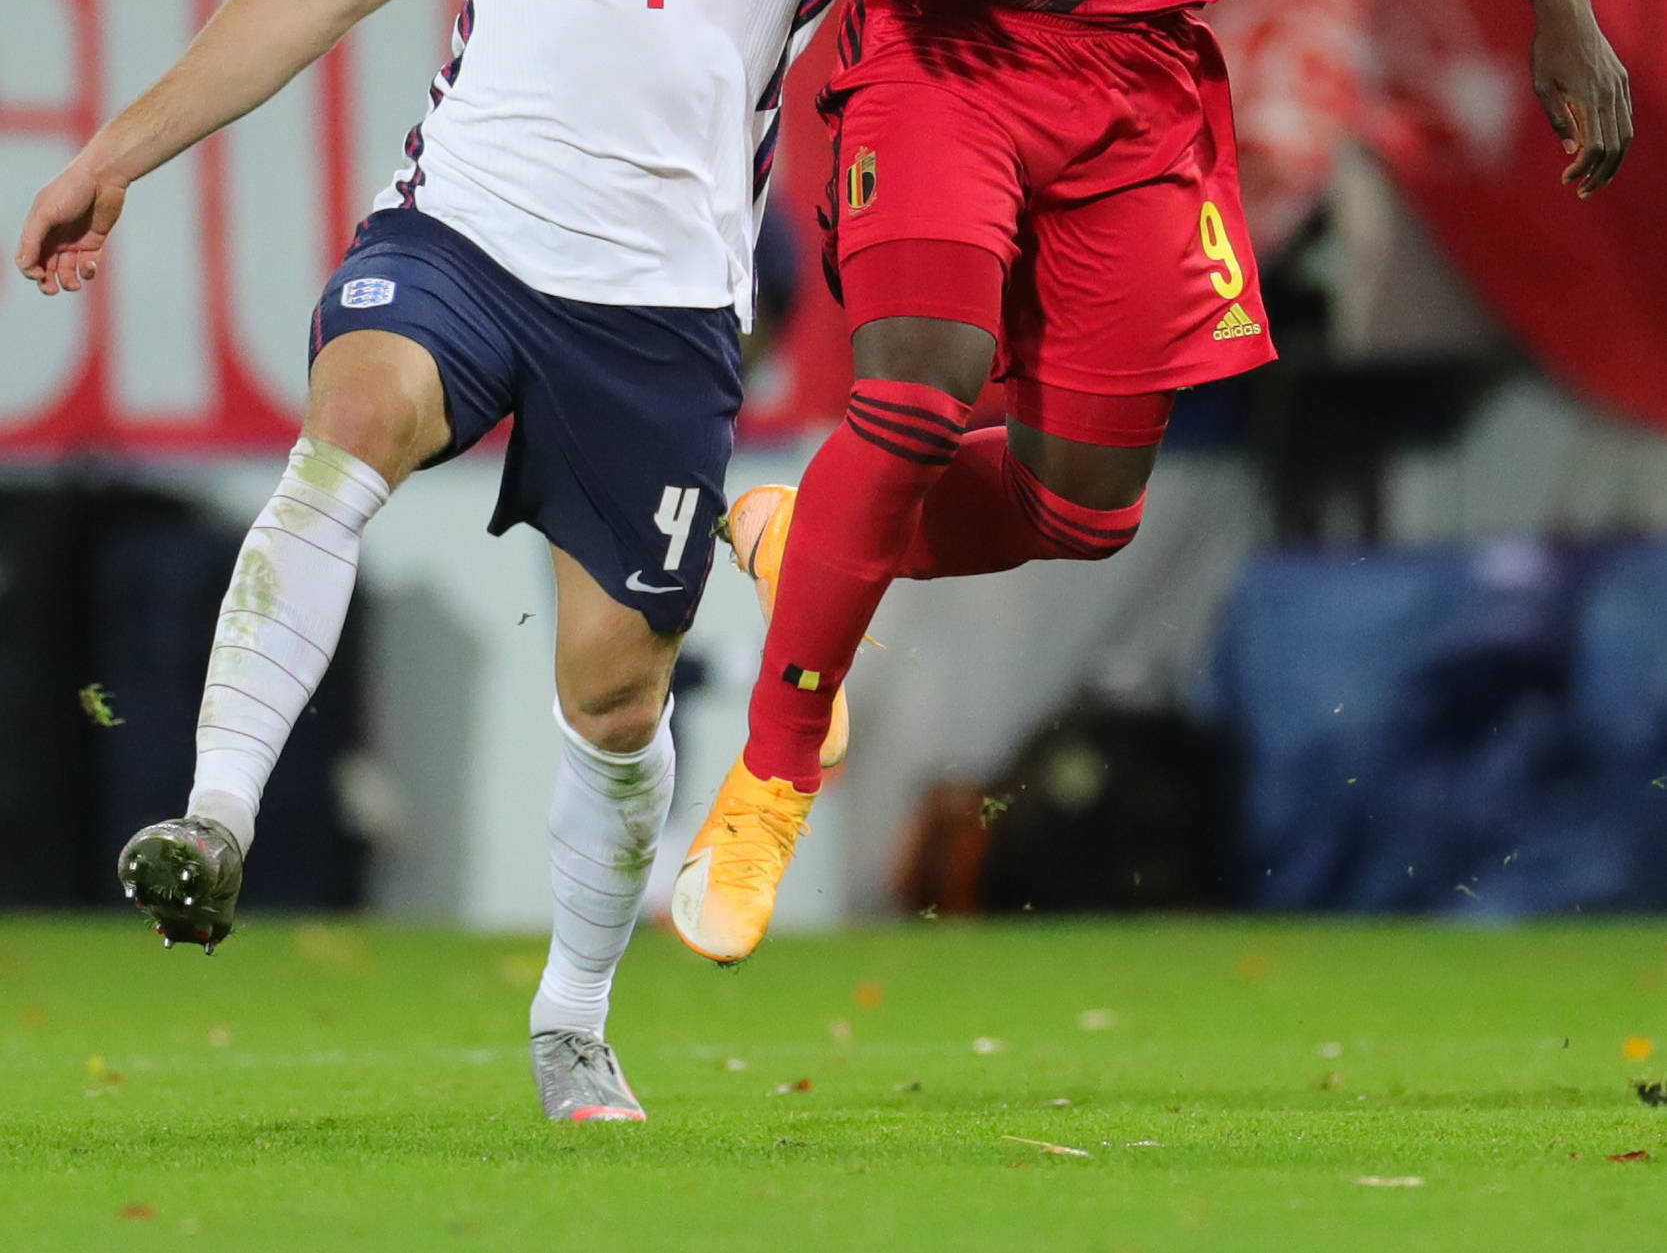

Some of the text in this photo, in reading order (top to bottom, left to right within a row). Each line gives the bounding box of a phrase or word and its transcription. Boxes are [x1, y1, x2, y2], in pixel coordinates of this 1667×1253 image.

[1200, 201, 1244, 299] 9
[1213, 323, 1262, 341] adidas
[653, 485, 701, 571] 4
